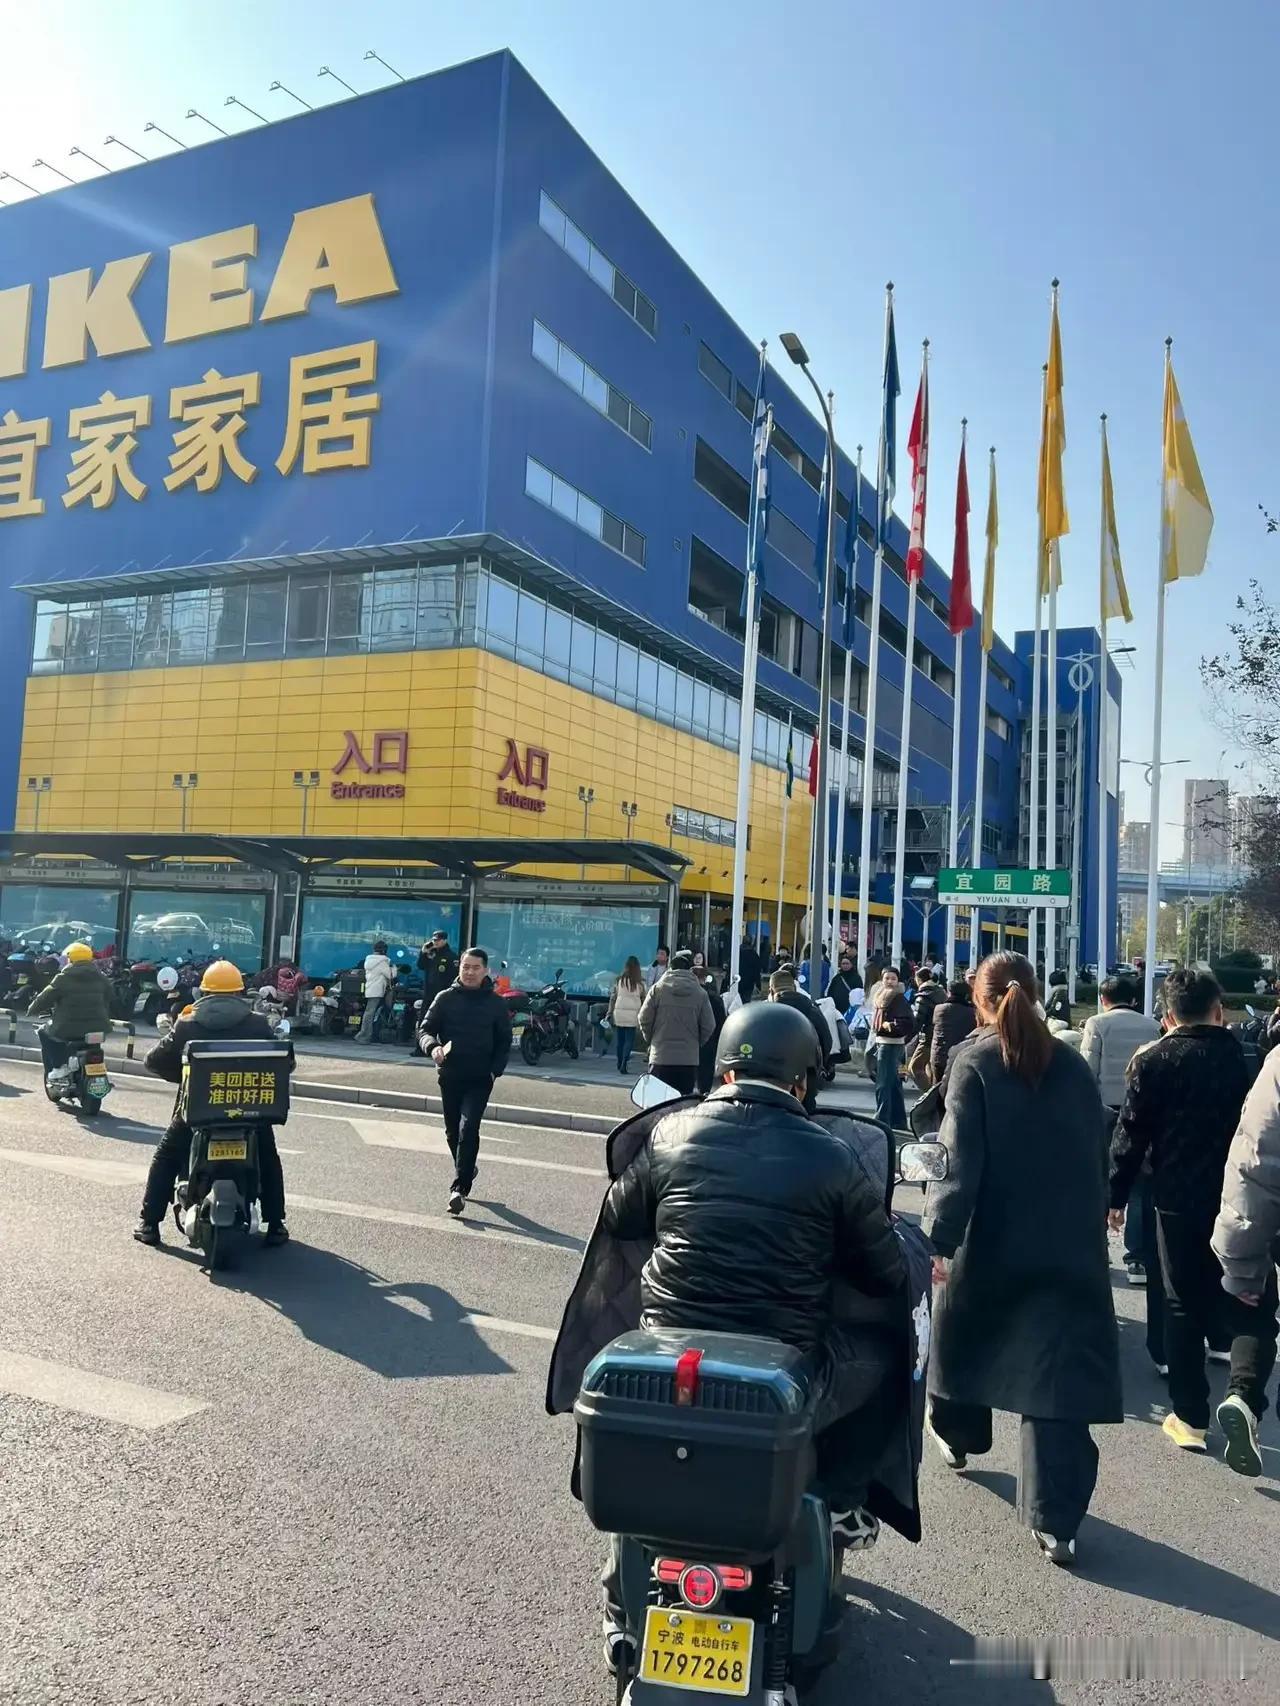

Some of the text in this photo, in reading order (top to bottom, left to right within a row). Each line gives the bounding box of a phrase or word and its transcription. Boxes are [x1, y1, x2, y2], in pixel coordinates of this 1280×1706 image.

[0, 192, 399, 380] IKEA
[0, 340, 380, 520] 宜家家居
[332, 729, 408, 775] 入口
[497, 737, 549, 790] 入口
[331, 781, 405, 800] Entrance
[496, 786, 547, 813] Entrance
[955, 873, 1051, 892] 宜园路
[976, 895, 1028, 904] YIYUAN LU
[209, 1072, 275, 1087] 美团配送
[208, 1089, 275, 1105] 准时好用
[658, 1629, 740, 1653] 宁波 电动自行车
[651, 1649, 743, 1683] 1797268
